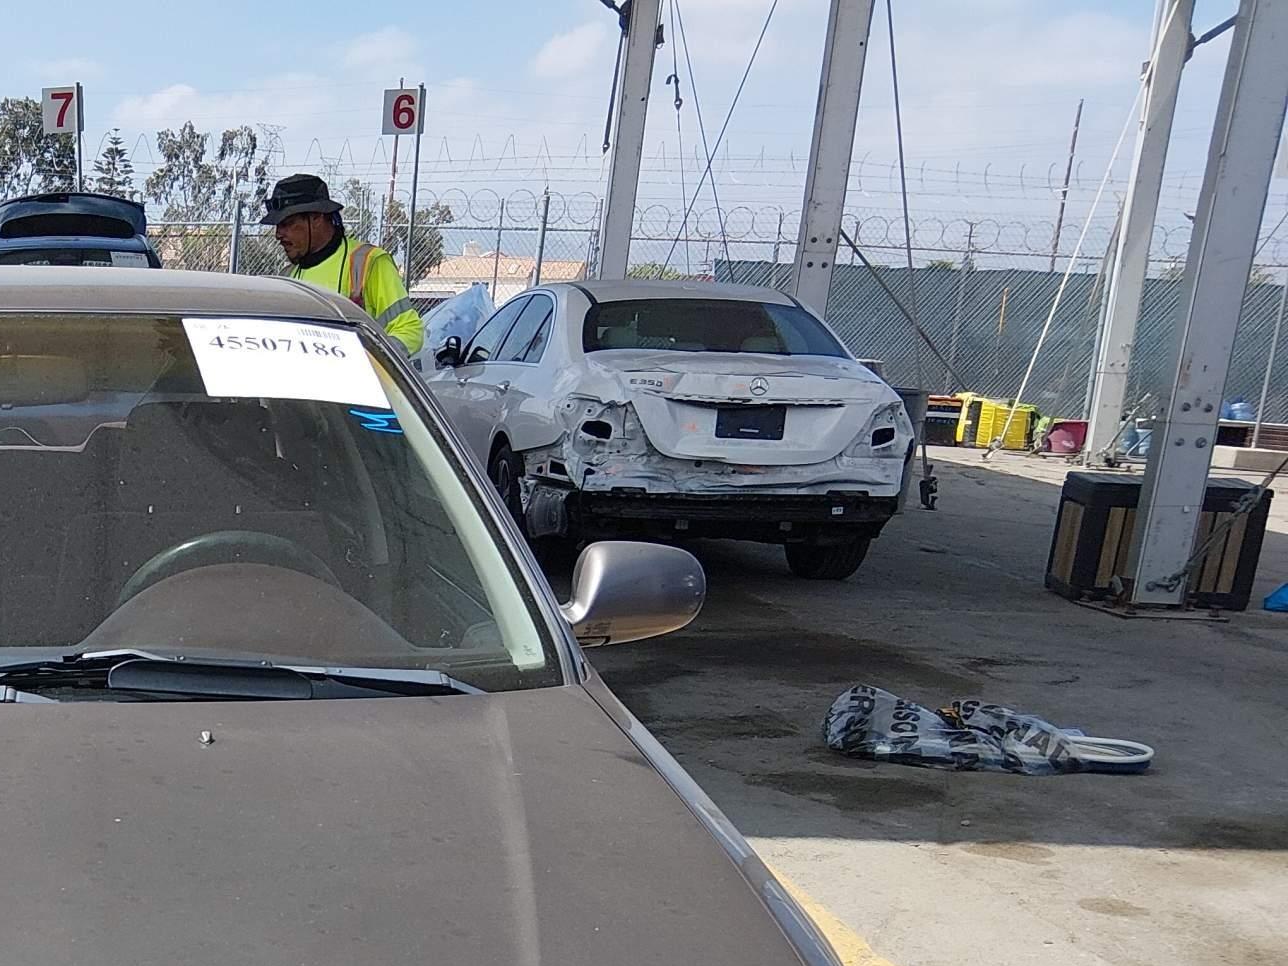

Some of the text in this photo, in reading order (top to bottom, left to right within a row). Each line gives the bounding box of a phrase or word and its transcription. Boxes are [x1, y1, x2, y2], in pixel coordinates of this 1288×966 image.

[50, 91, 73, 128] 7
[392, 94, 415, 129] 6
[208, 335, 347, 359] 45507186
